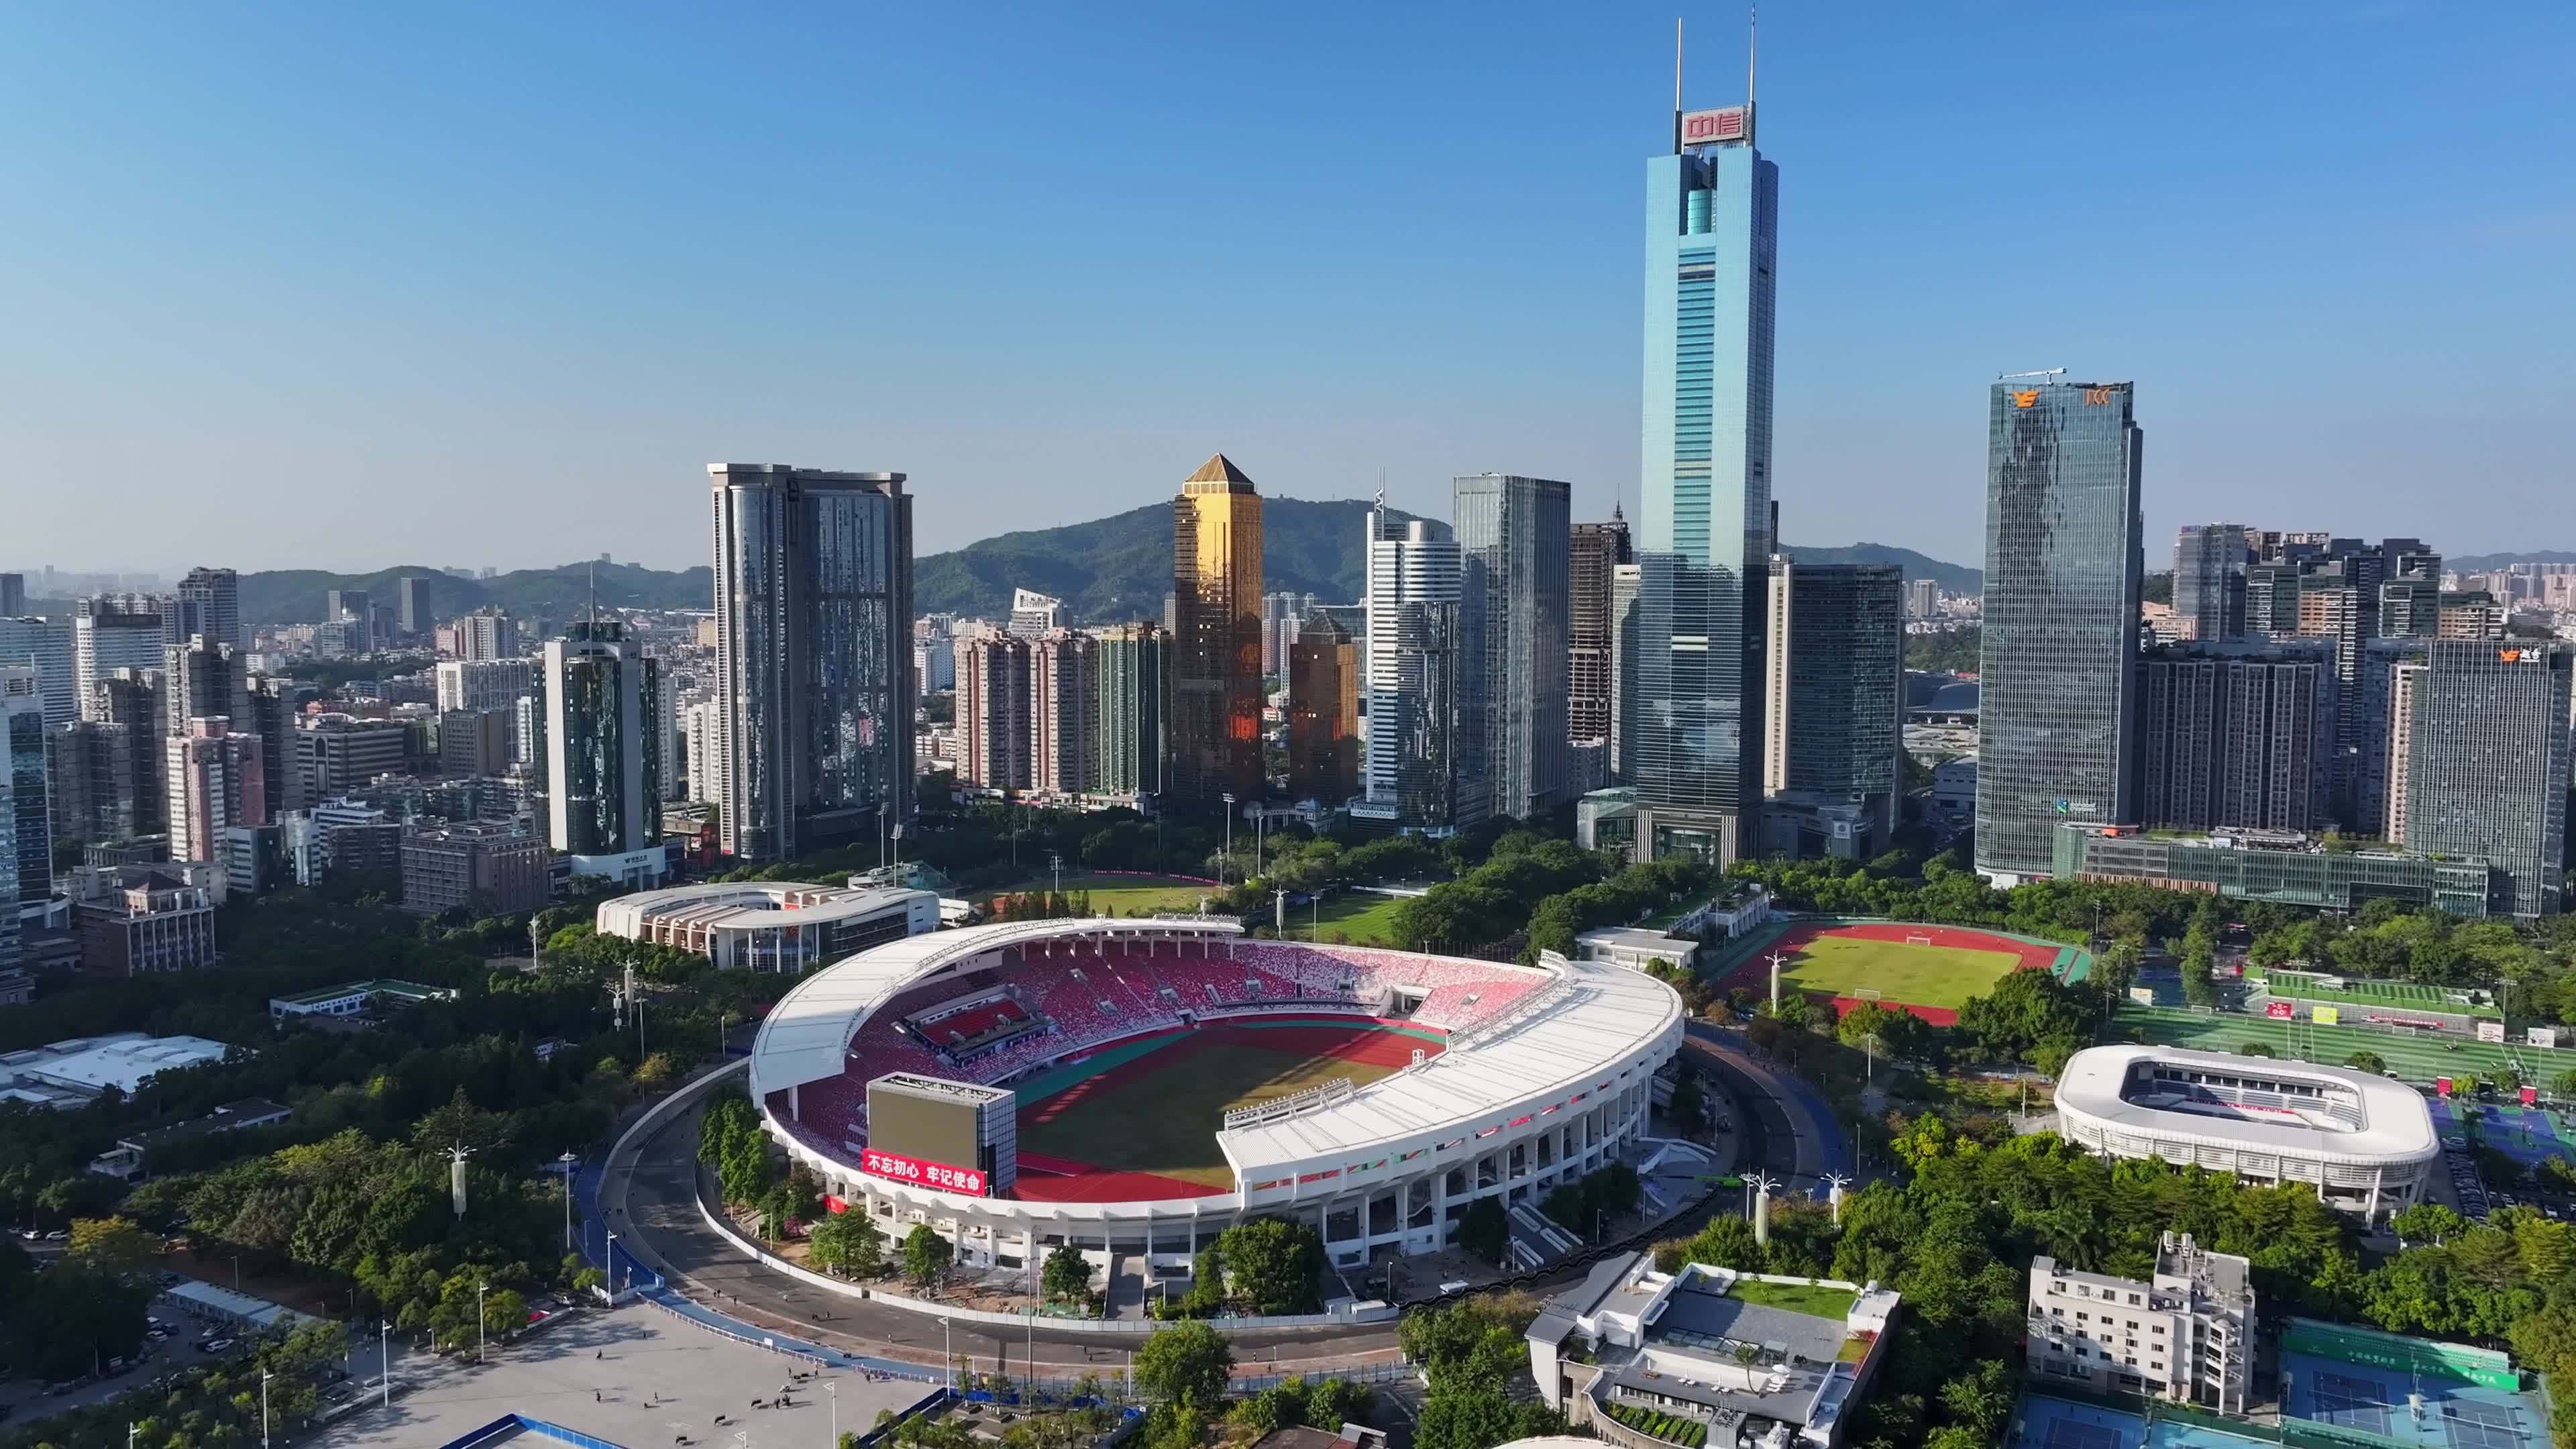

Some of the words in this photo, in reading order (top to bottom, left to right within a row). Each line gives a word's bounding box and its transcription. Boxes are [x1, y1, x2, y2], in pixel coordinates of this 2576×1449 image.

[1686, 113, 1741, 138] 中信
[868, 1154, 919, 1179] 不忘初心
[926, 1166, 980, 1191] 牢记使命
